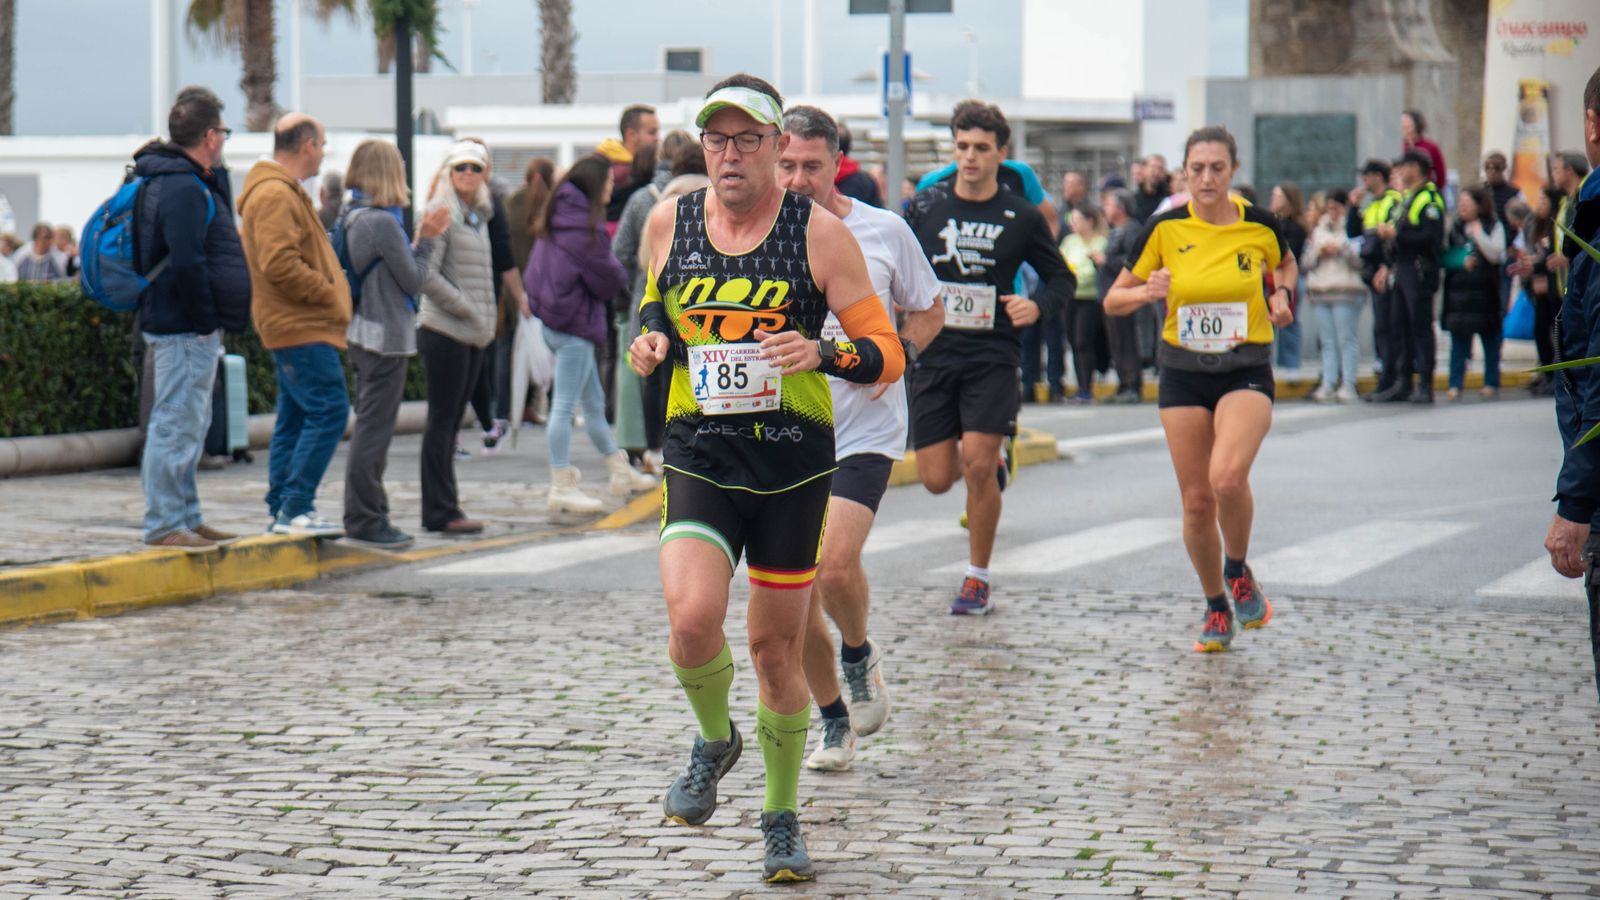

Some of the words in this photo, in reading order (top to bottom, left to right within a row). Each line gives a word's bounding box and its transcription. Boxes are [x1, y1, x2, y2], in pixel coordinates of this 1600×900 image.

[959, 221, 1004, 240] XIV
[953, 295, 974, 313] 20
[1201, 316, 1222, 336] 60
[703, 349, 729, 363] XIV
[717, 363, 749, 390] 85
